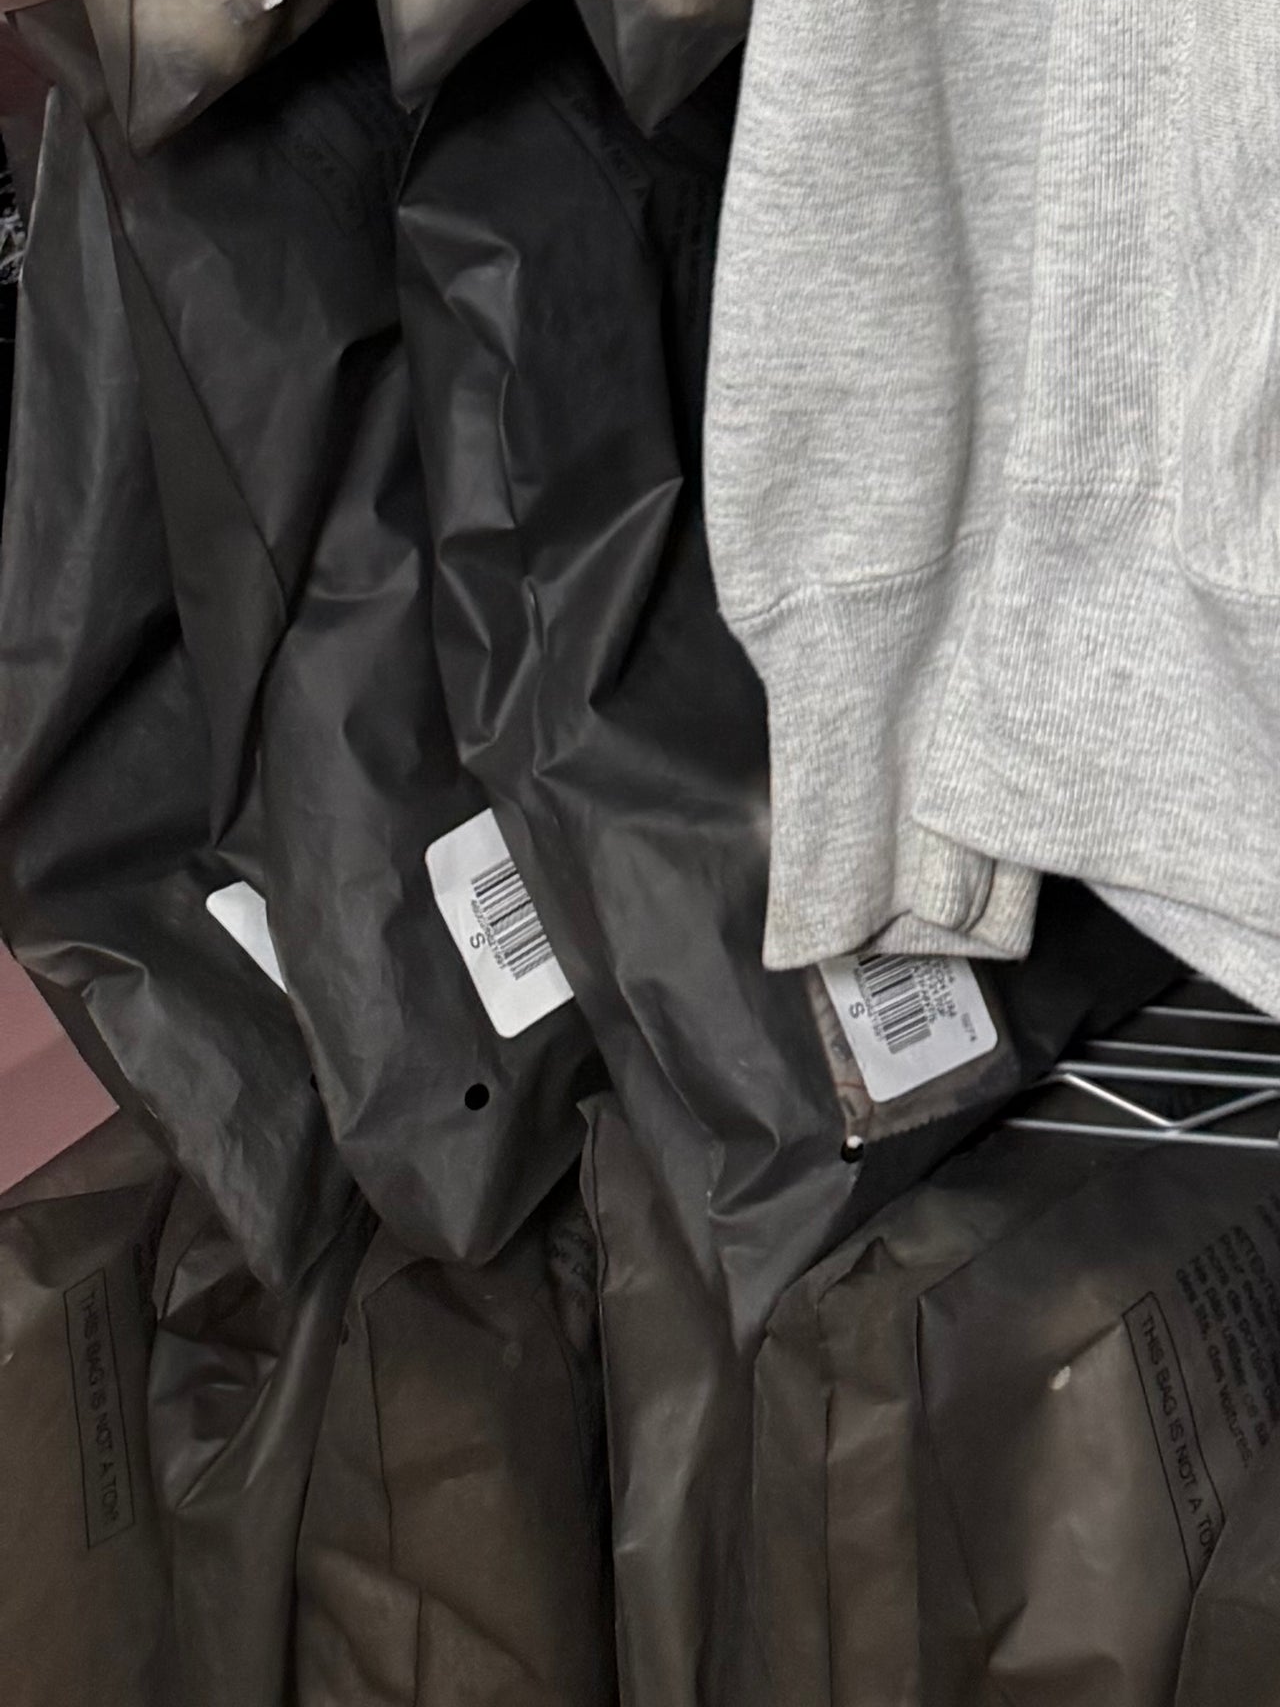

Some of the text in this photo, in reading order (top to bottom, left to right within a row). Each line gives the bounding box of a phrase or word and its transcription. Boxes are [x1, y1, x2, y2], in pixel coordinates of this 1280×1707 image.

[469, 932, 486, 950] S
[849, 1001, 866, 1020] S
[1141, 1314, 1204, 1514] THIS BAG IS NOT A
